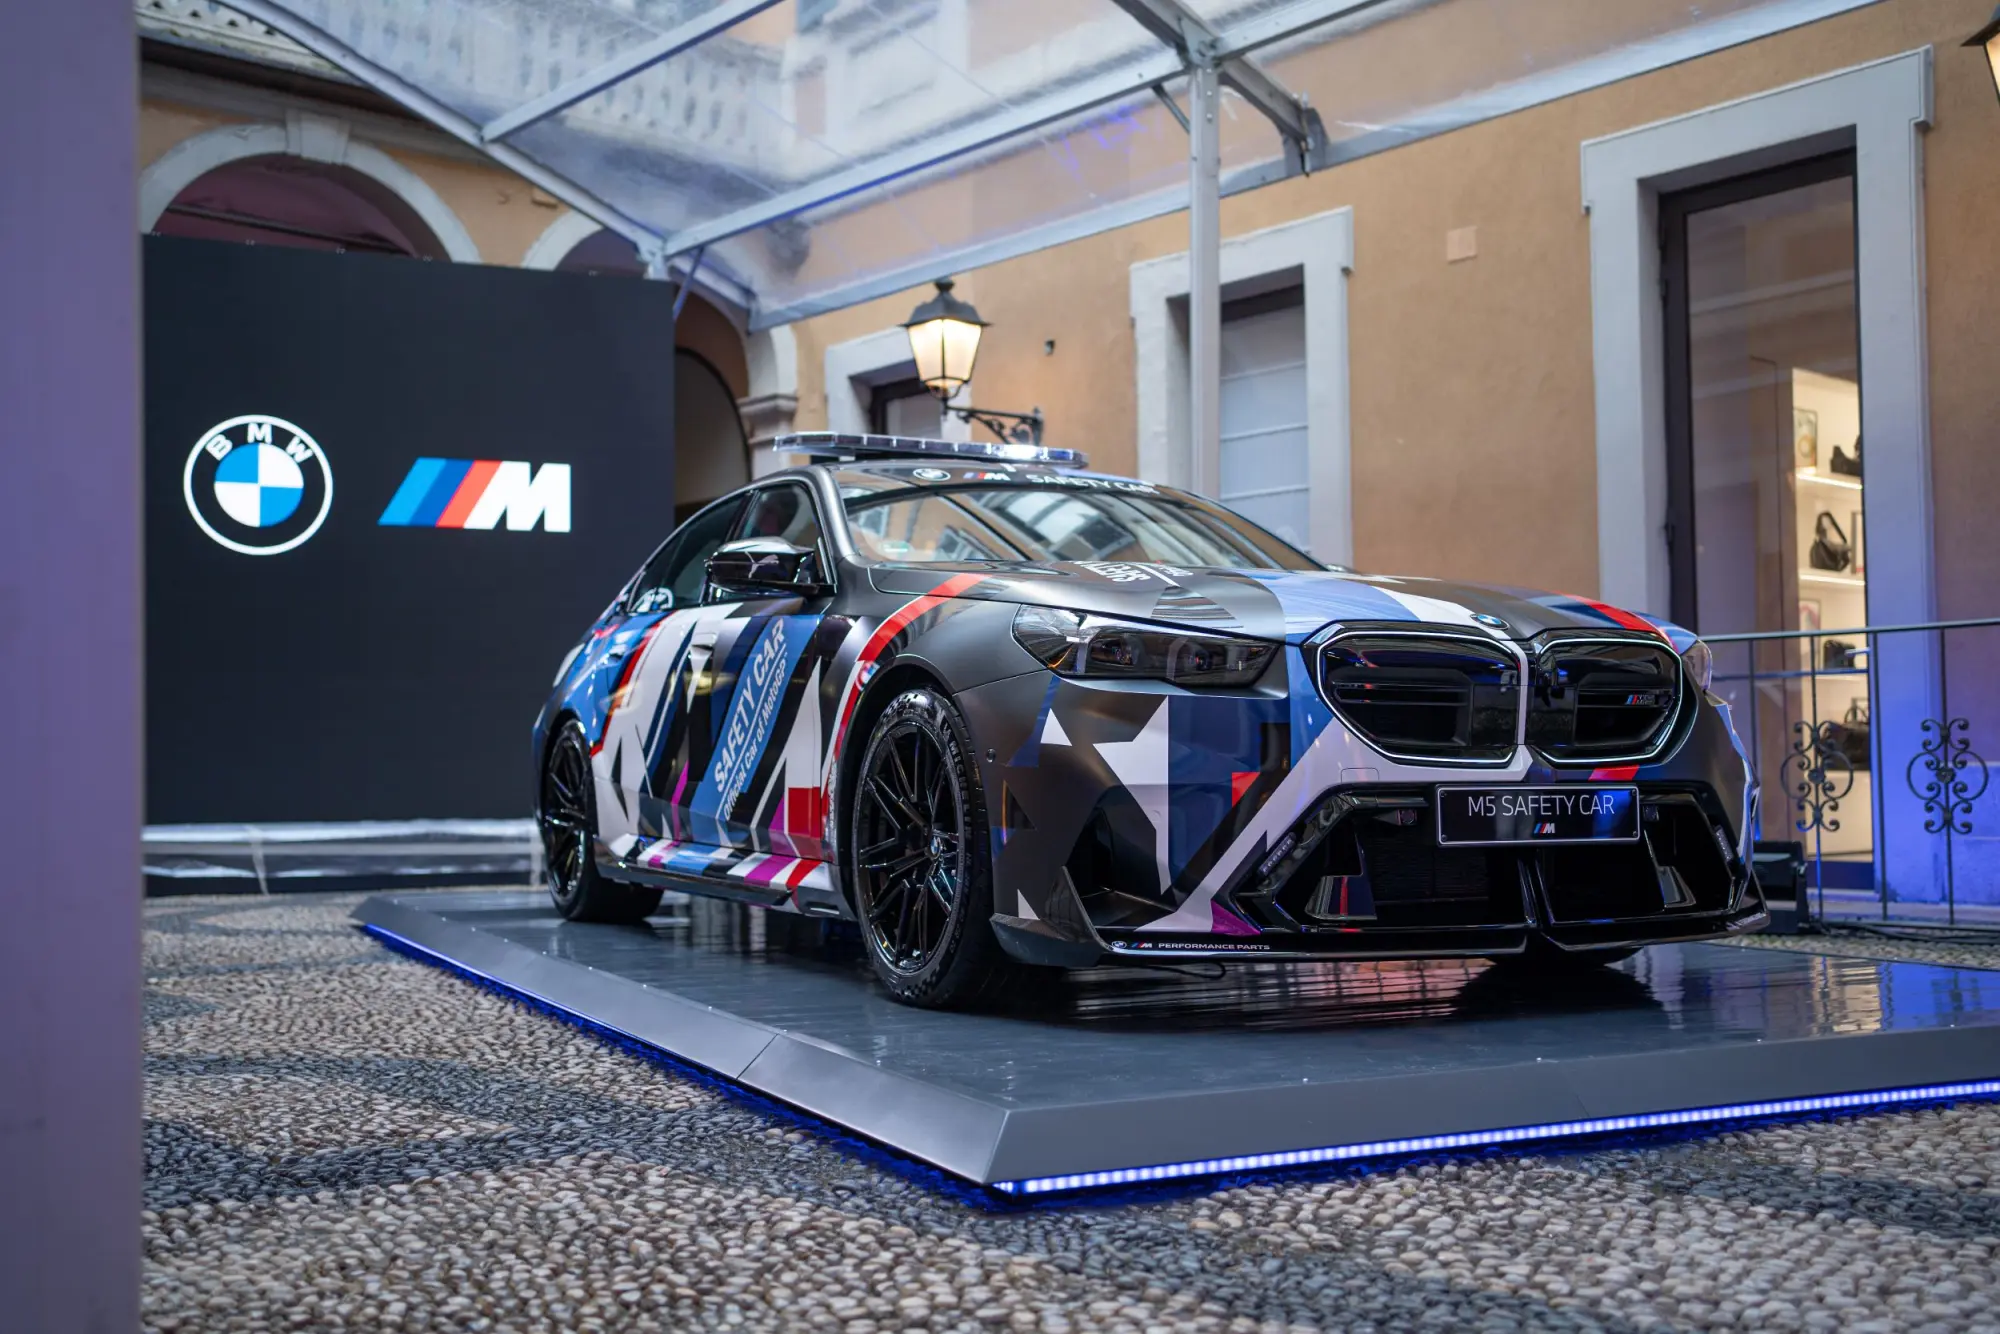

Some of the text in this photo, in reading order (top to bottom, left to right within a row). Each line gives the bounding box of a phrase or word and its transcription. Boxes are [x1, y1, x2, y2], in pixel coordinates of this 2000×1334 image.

[205, 422, 313, 462] BMW
[1026, 473, 1111, 489] SAFETY
[1114, 481, 1160, 495] CAR
[714, 617, 785, 793] SAFETY CAR
[723, 763, 747, 822] Official
[744, 738, 758, 771] Car
[756, 716, 765, 742] of
[1468, 795, 1615, 816] M5 SAFETY CAR
